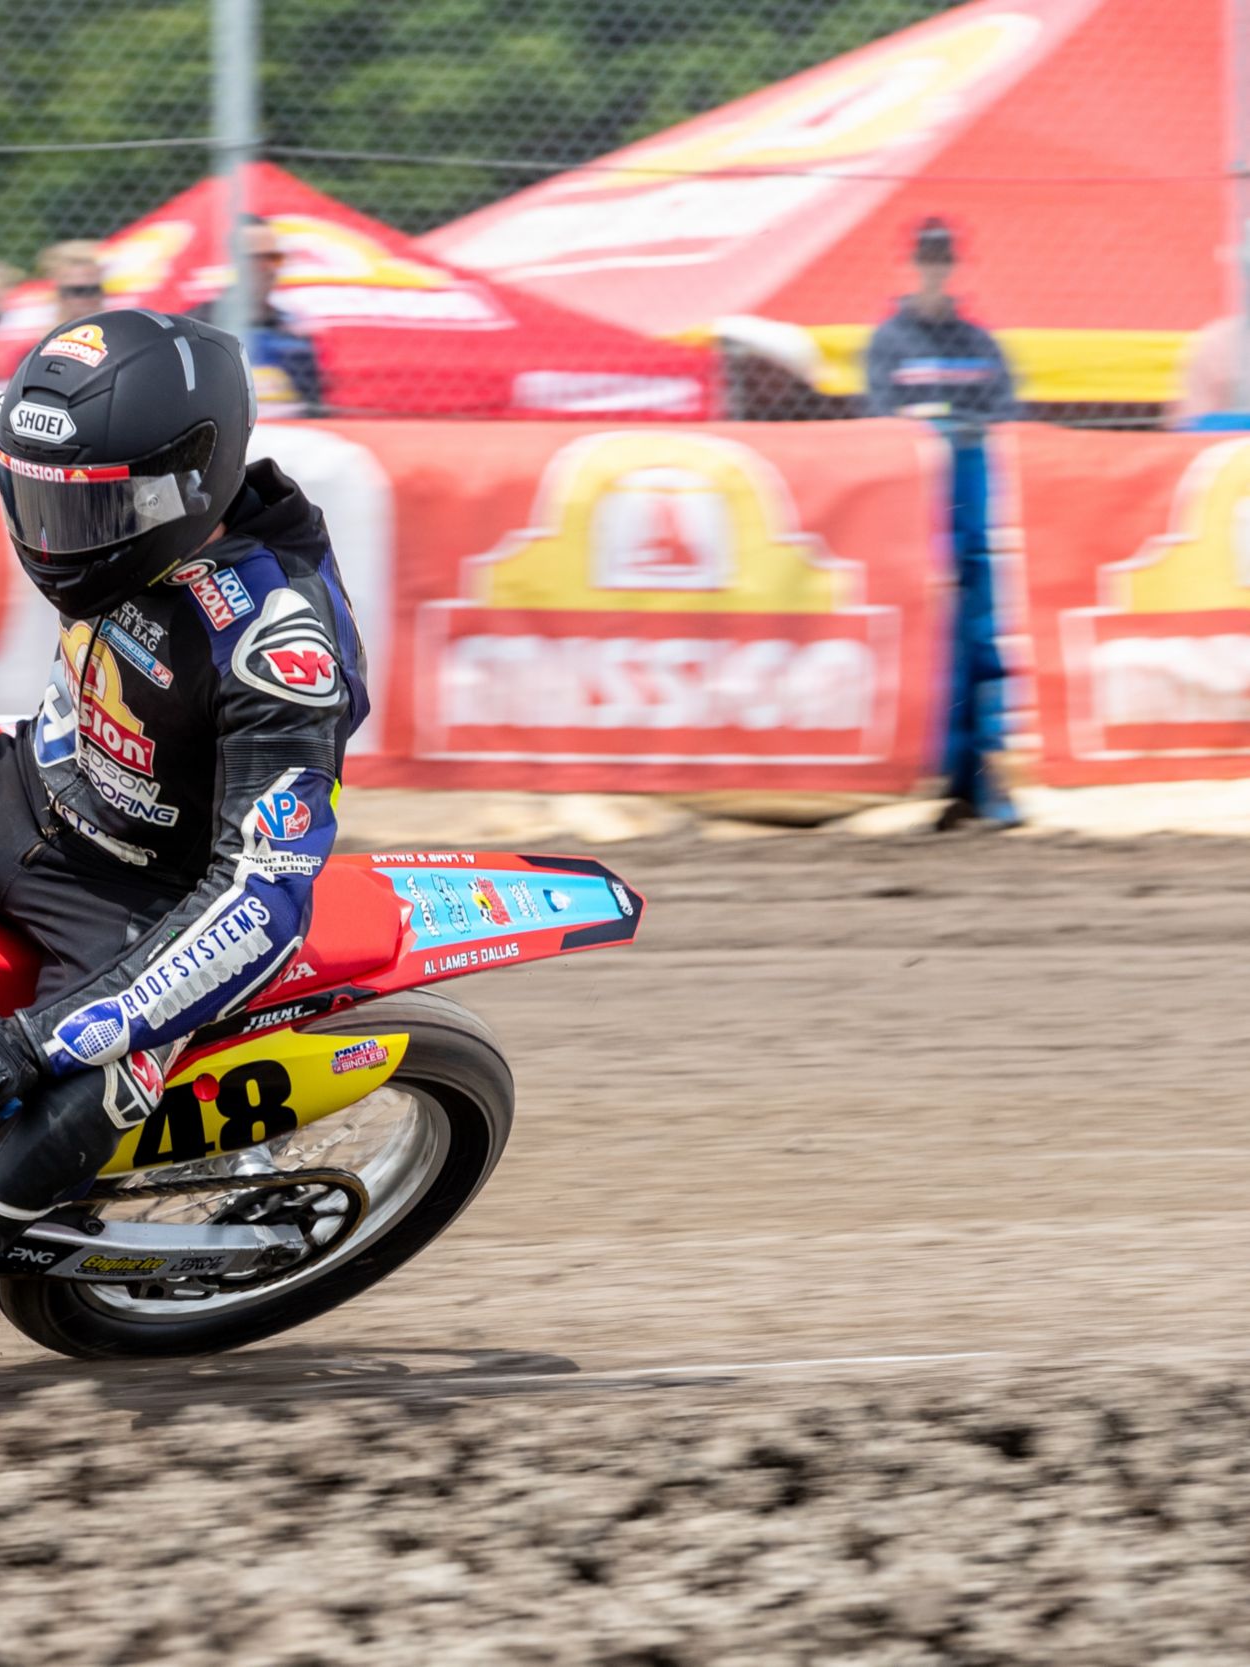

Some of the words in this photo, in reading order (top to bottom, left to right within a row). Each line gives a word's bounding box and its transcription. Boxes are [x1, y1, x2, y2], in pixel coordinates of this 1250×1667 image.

[16, 409, 64, 437] SHOEI
[10, 457, 66, 482] mission
[193, 576, 235, 630] MOLY
[213, 568, 252, 617] LIQUI
[132, 624, 158, 652] BAG
[254, 791, 297, 838] VP
[424, 960, 438, 976] AL
[440, 951, 479, 972] LAMB'S
[480, 942, 520, 964] DALLAS
[250, 1004, 304, 1026] TRENT
[335, 1040, 377, 1058] PARTS
[341, 1050, 385, 1072] SINGLES
[133, 1059, 298, 1169] 48
[7, 1247, 55, 1265] PNG
